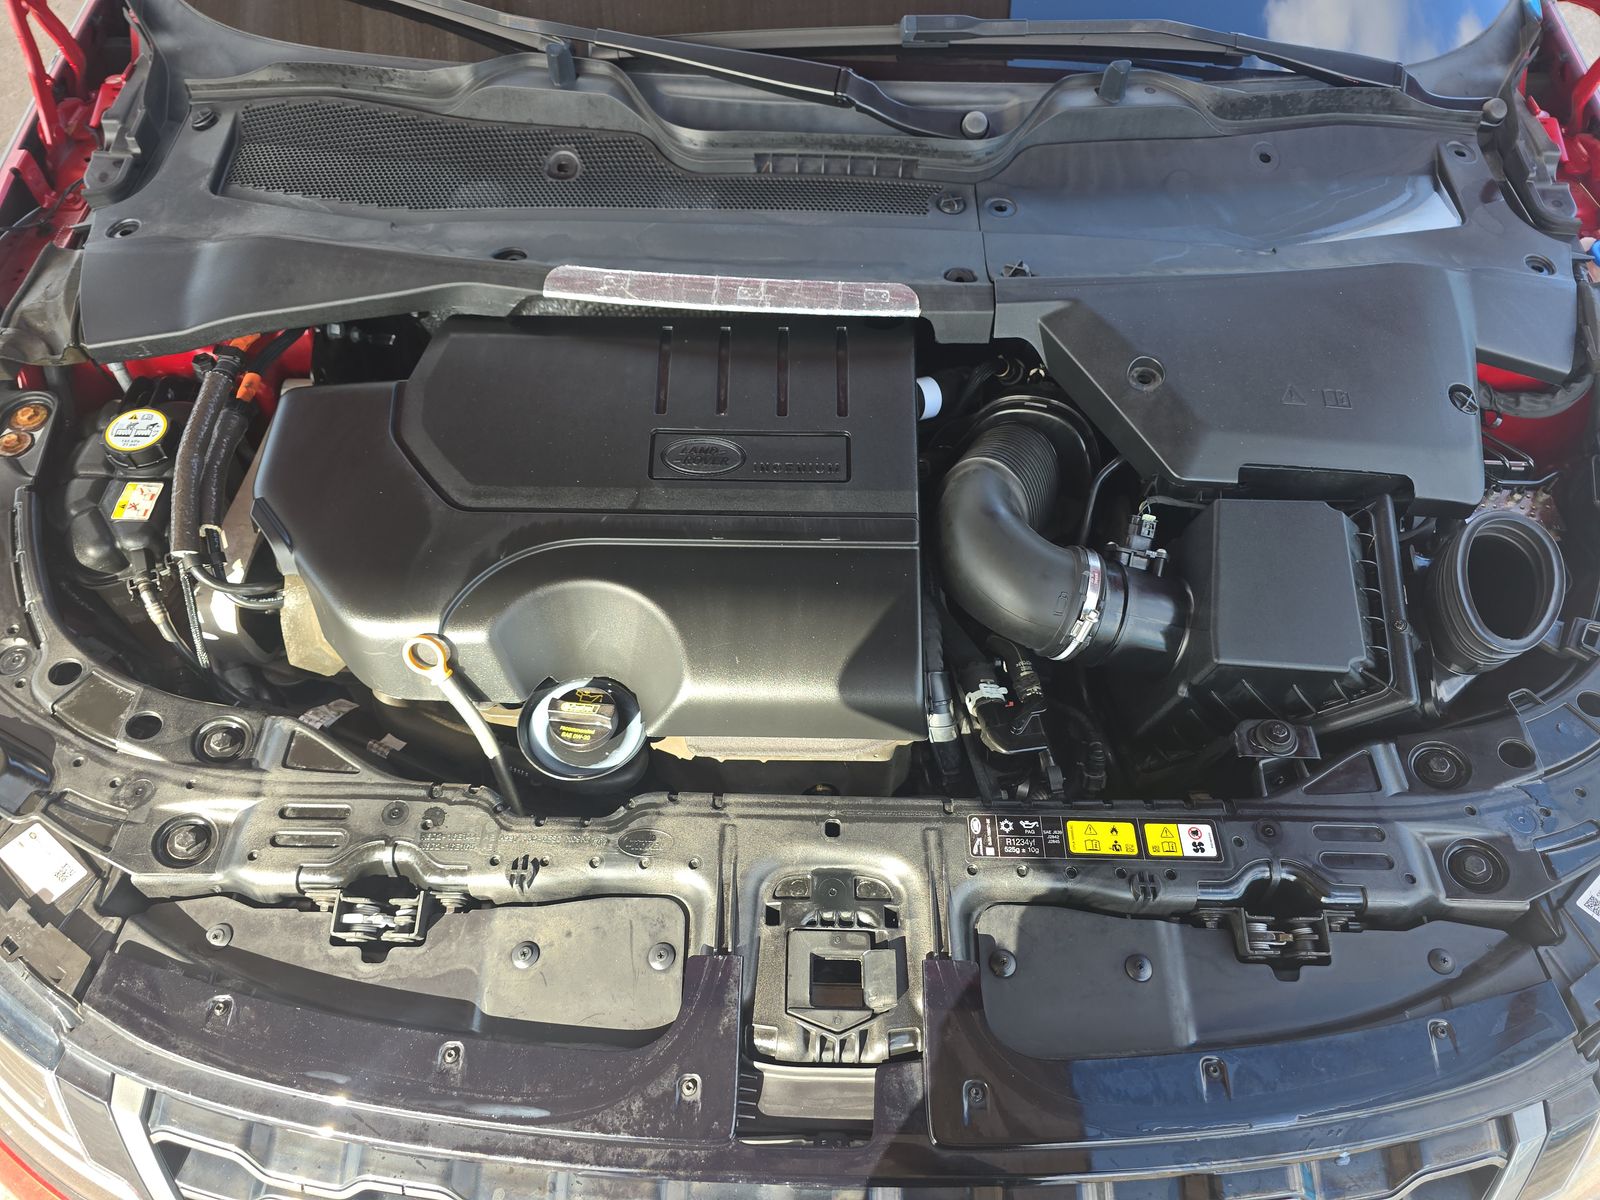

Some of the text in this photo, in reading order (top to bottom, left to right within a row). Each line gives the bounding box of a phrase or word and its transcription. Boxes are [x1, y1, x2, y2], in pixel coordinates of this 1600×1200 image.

[680, 446, 719, 455] LAND
[682, 456, 730, 466] ROVER
[1005, 838, 1036, 847] R1234yf
[1004, 846, 1020, 854] 525g
